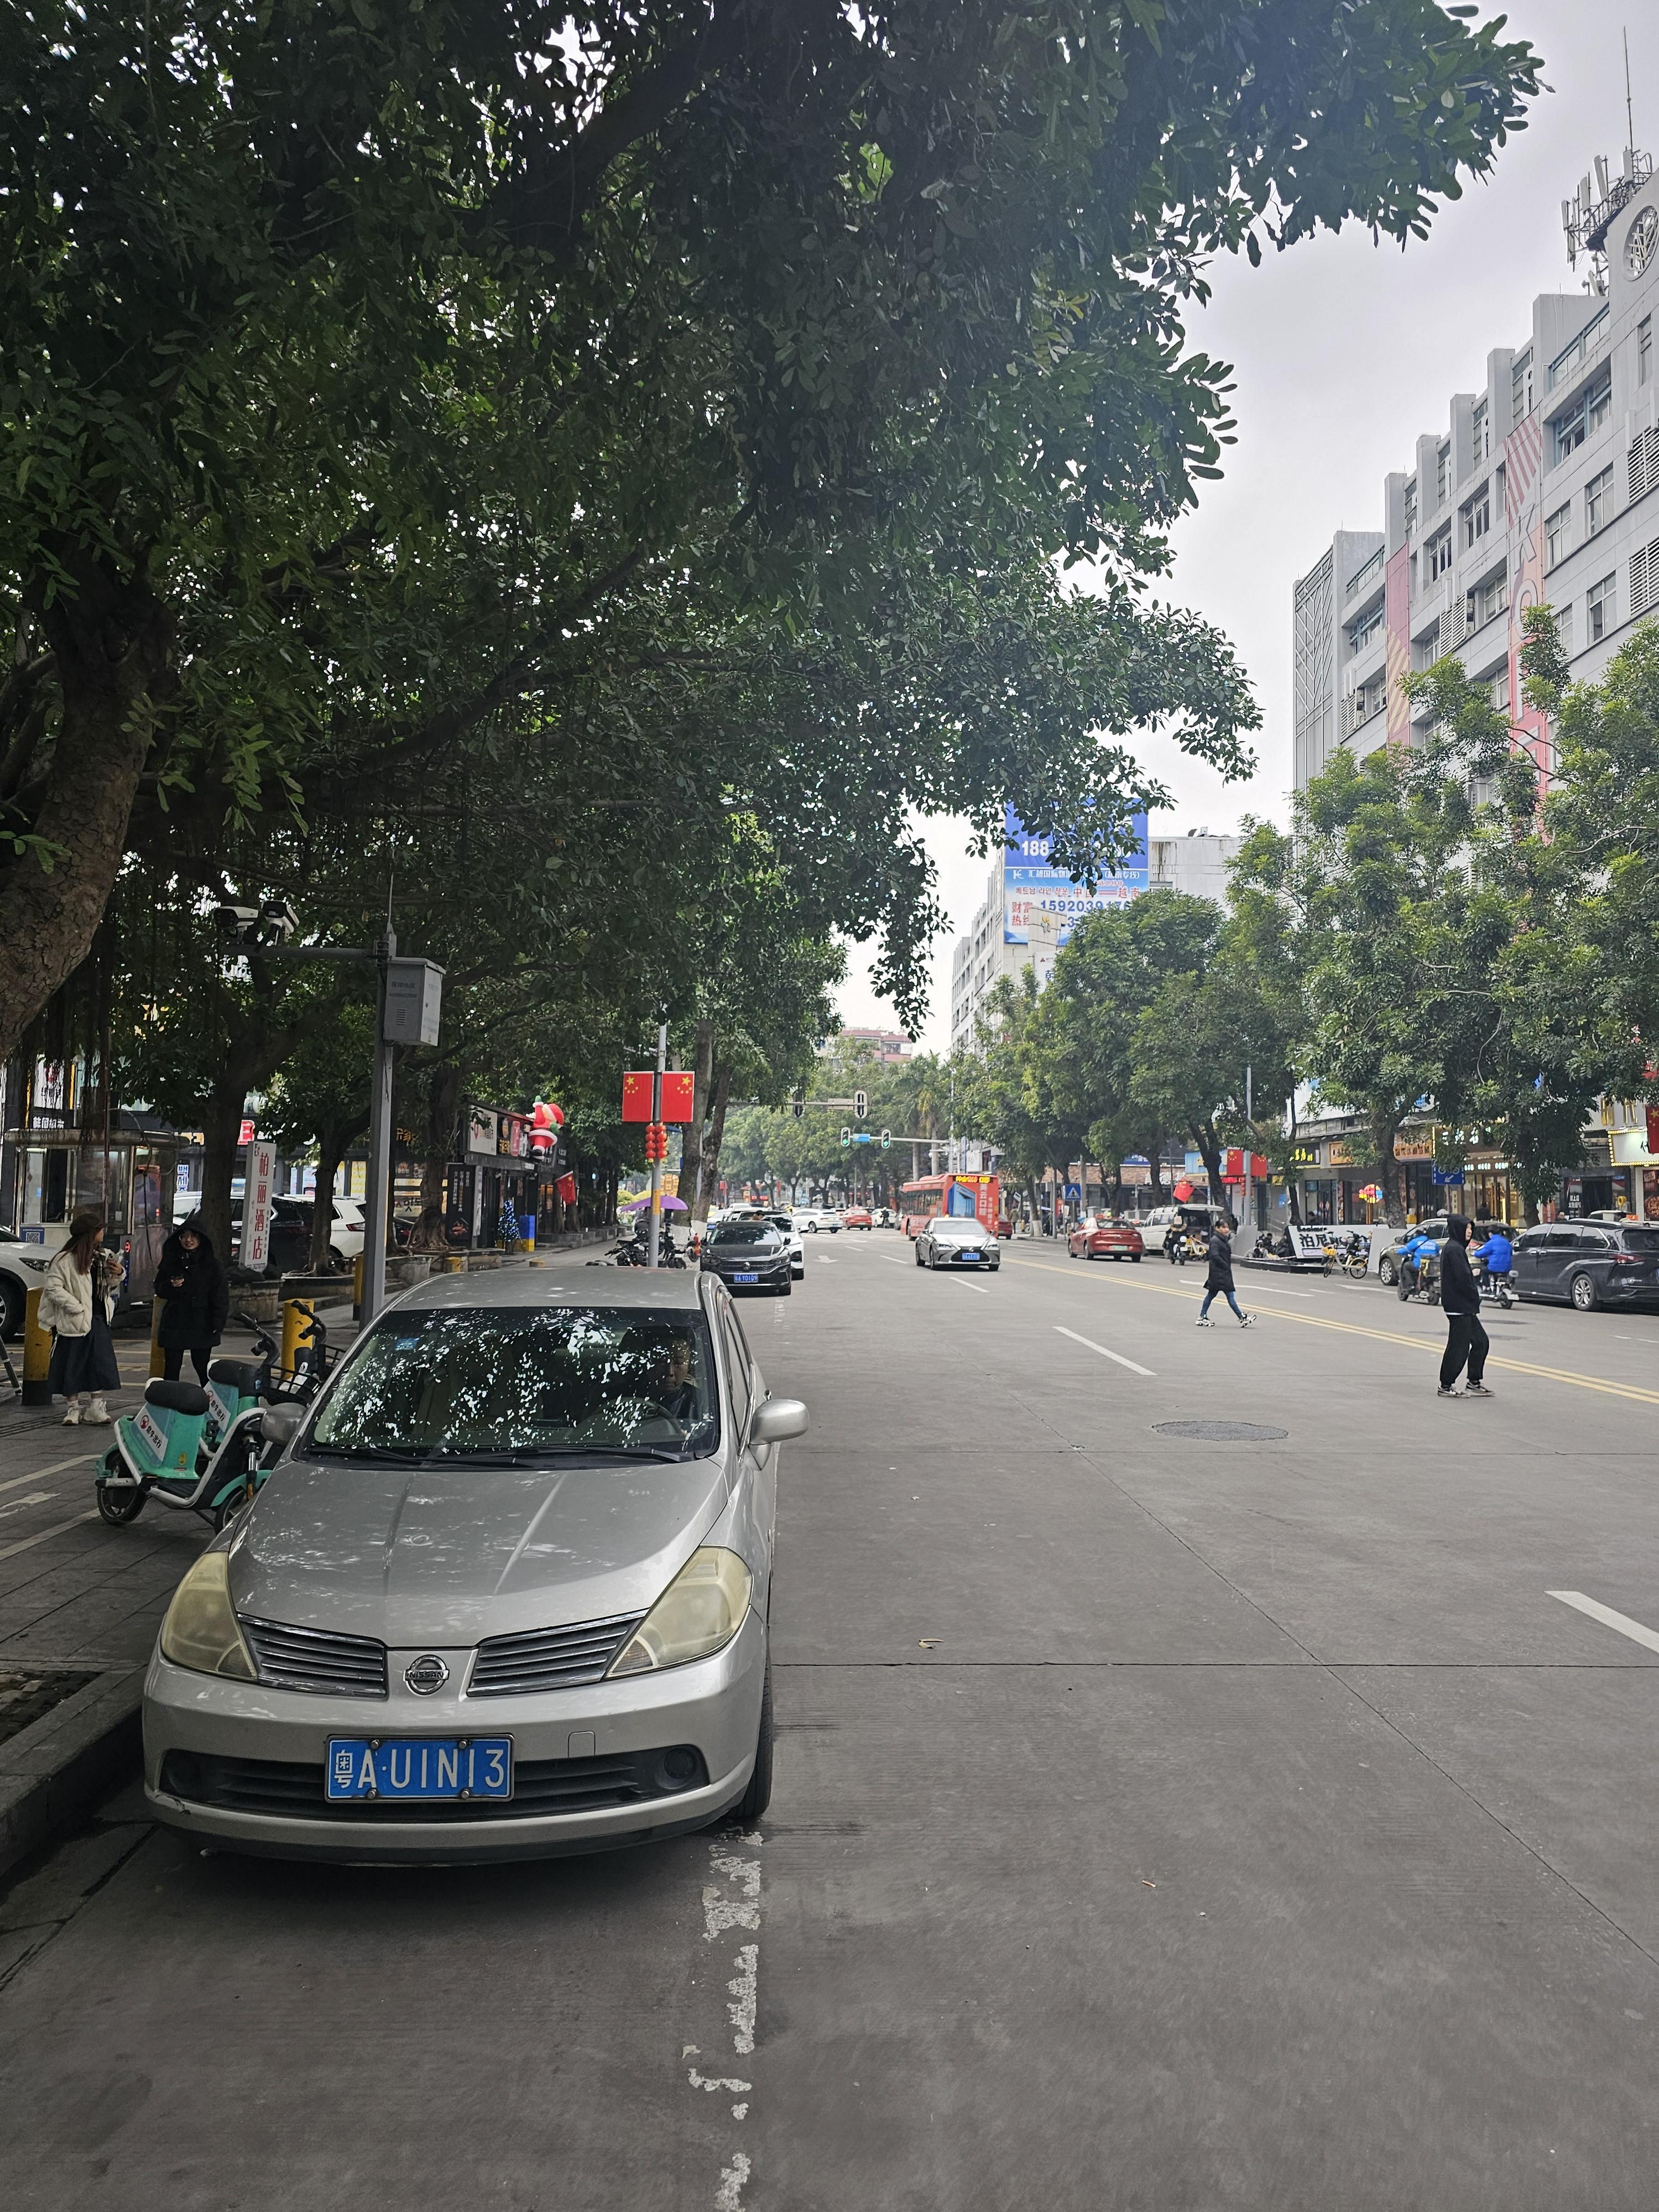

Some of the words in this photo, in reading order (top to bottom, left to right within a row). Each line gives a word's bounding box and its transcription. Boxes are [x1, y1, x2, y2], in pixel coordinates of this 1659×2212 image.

[1039, 886, 1052, 895] 라인
[252, 1152, 269, 1259] 柏丽酒店
[409, 1671, 444, 1679] NISSAN
